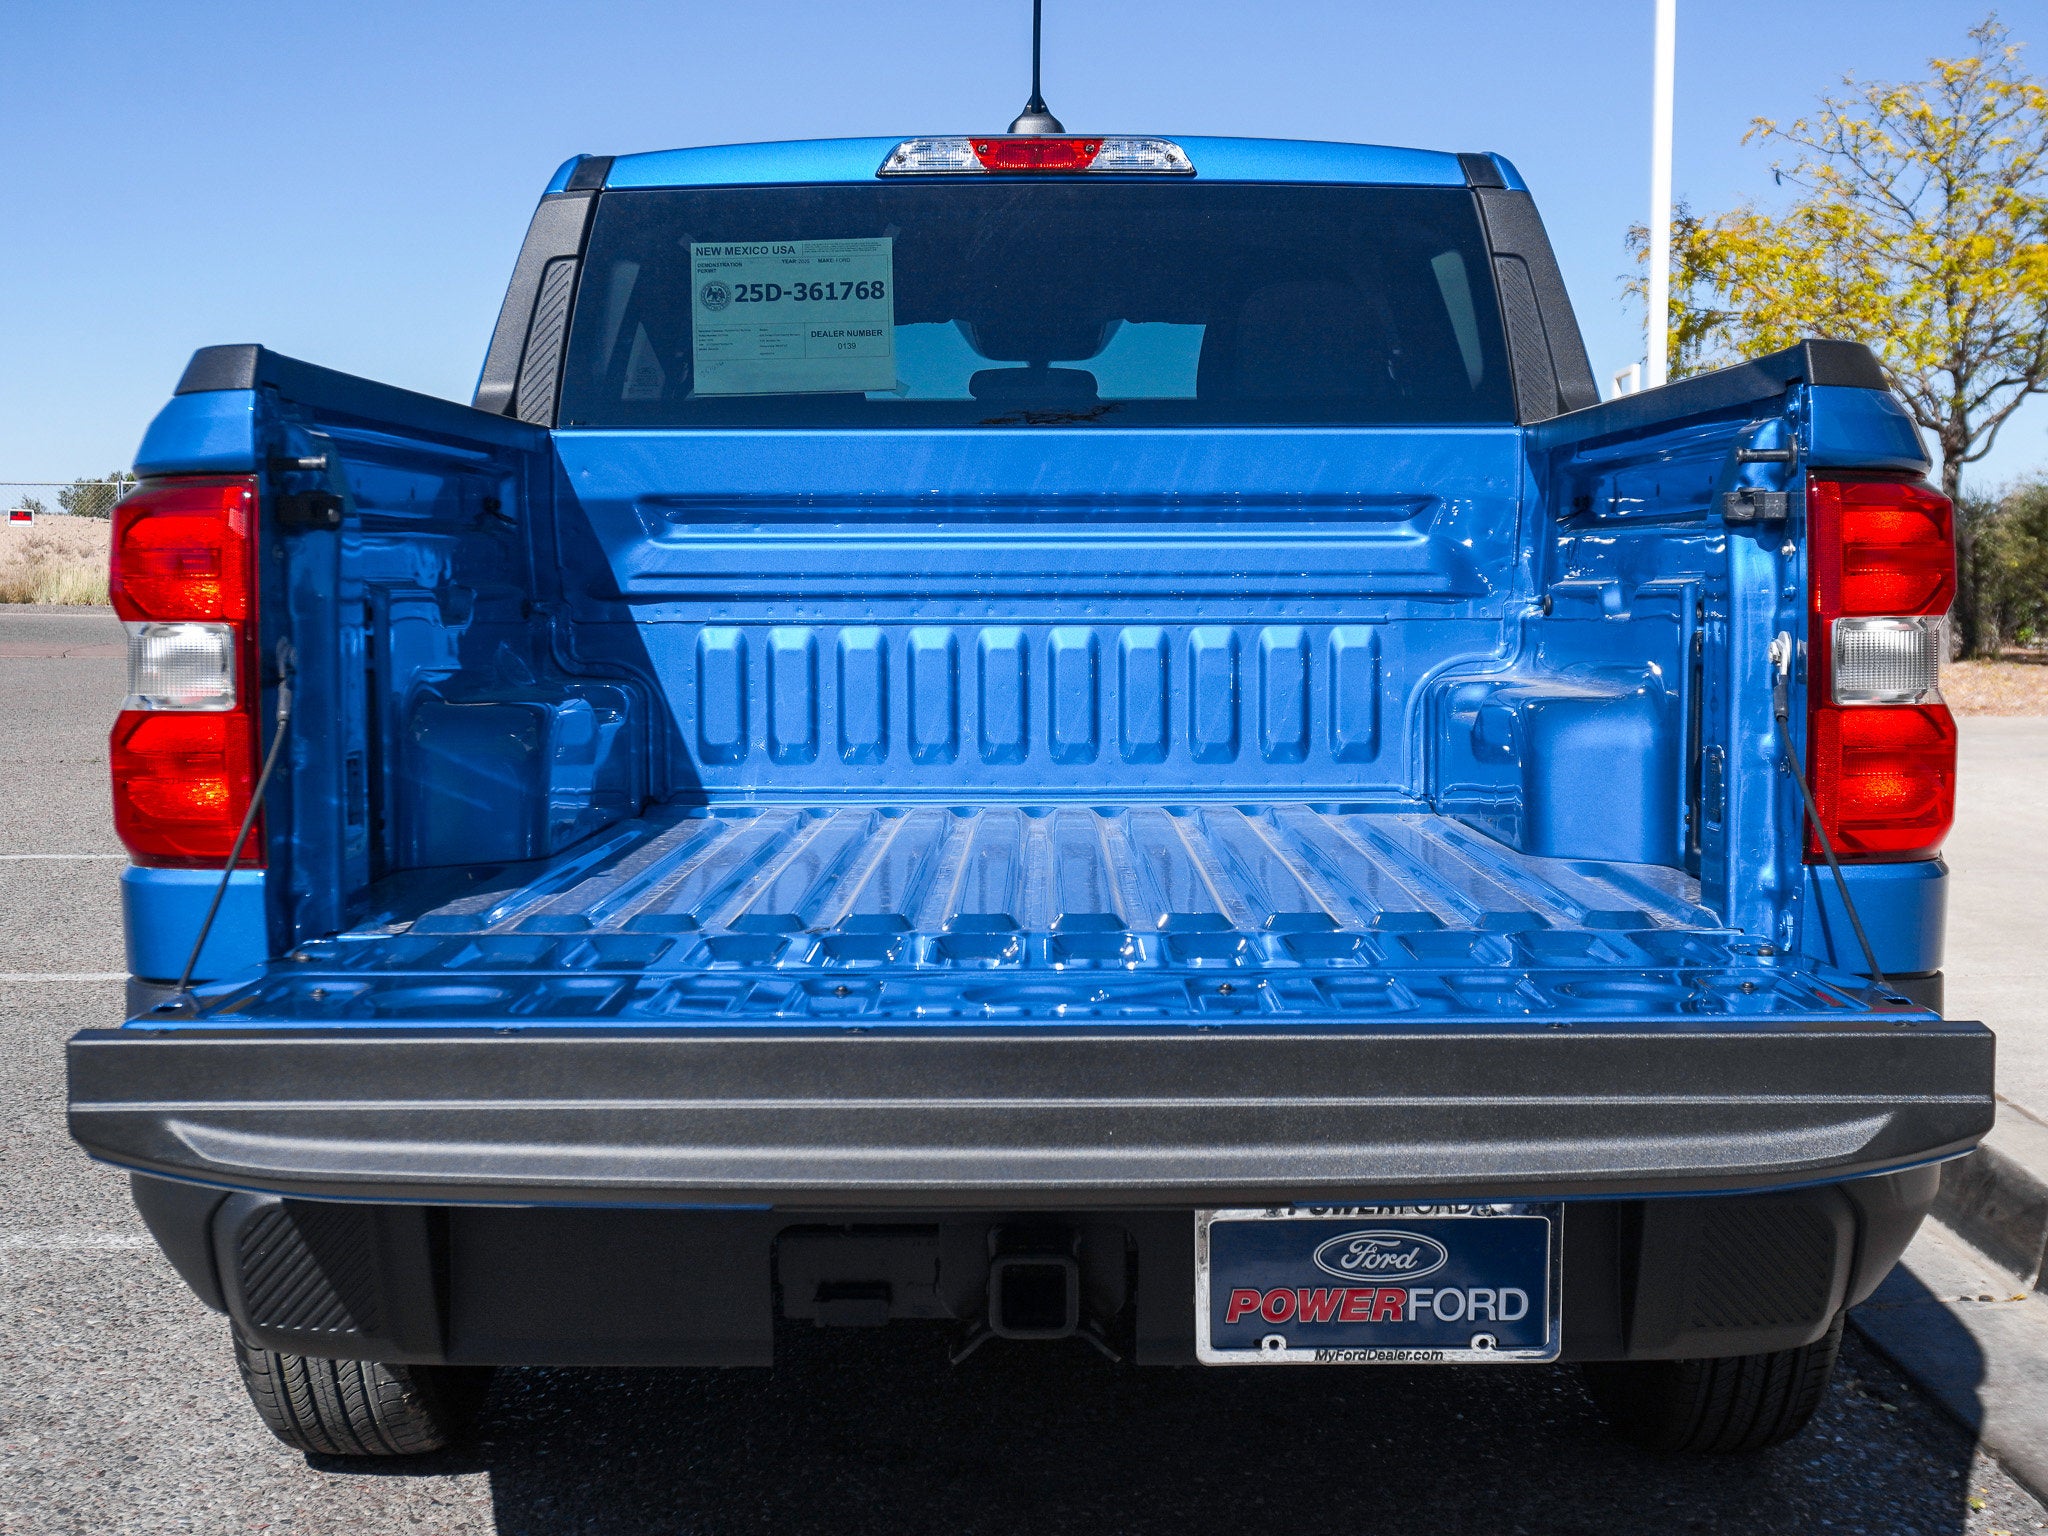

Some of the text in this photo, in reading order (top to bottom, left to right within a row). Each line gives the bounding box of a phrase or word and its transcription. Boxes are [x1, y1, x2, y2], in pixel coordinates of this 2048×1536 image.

[696, 246, 722, 256] NEW
[725, 246, 769, 256] MEXICO
[772, 245, 796, 255] USA
[734, 280, 885, 303] 25D-361768
[811, 329, 883, 338] DEALER NUMBER
[837, 342, 857, 350] 0139
[1340, 1239, 1419, 1270] Ford
[1226, 1287, 1529, 1323] POWERFORD
[1314, 1349, 1444, 1363] MyFordDealer.com
